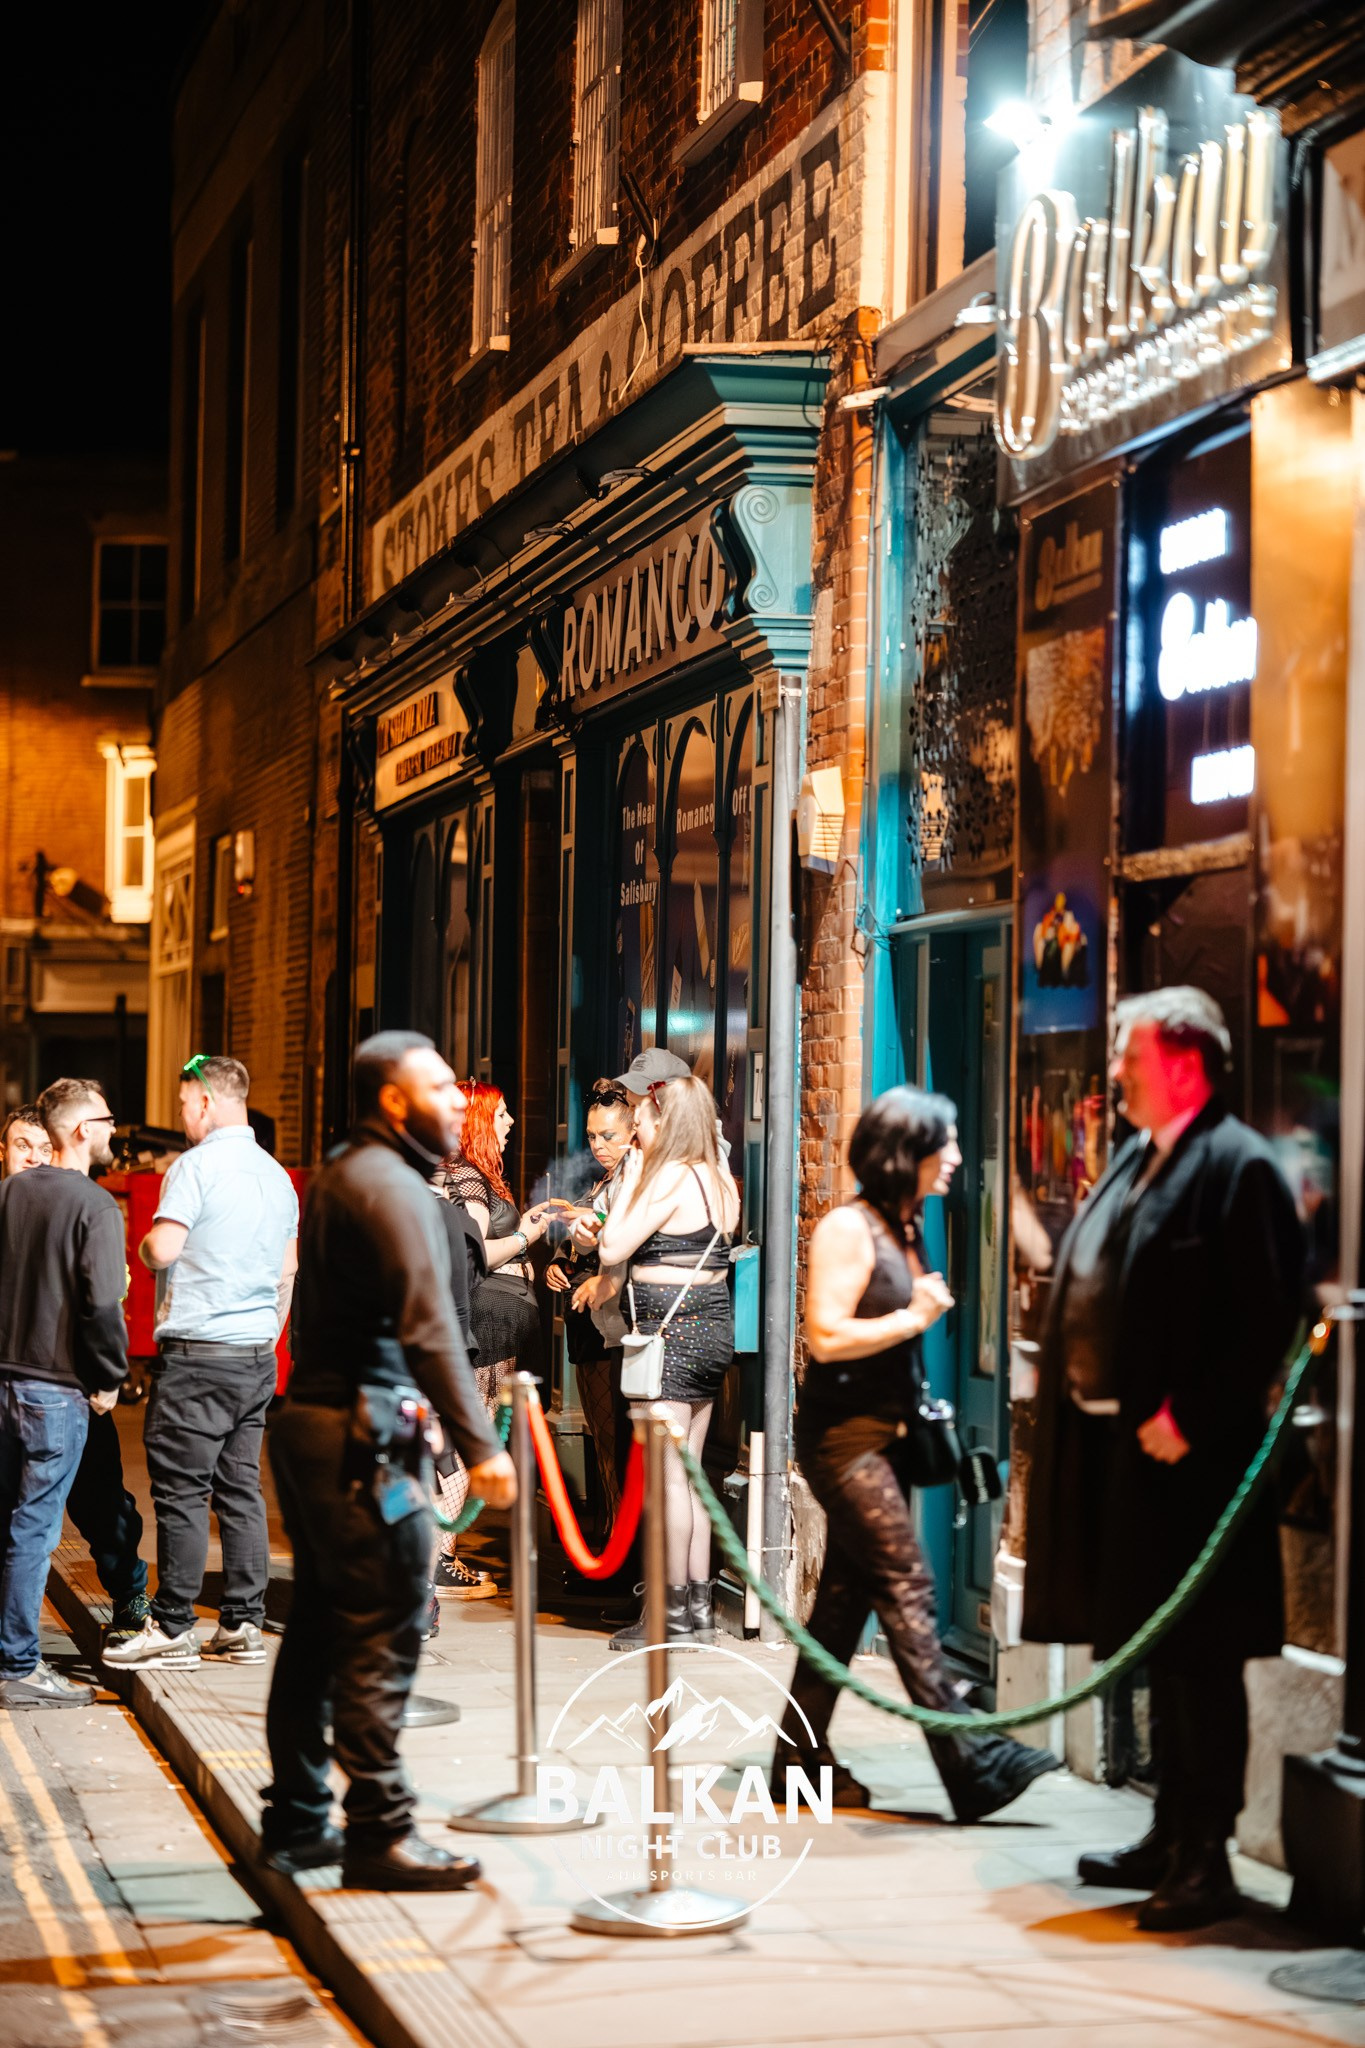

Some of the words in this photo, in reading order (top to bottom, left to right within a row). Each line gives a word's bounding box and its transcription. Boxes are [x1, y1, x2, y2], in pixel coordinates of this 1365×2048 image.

[513, 358, 584, 480] TEA
[561, 518, 719, 702] ROMANCO
[622, 806, 636, 831] The
[676, 802, 714, 834] Romanco
[634, 838, 645, 866] Of
[620, 879, 658, 907] Salisbury
